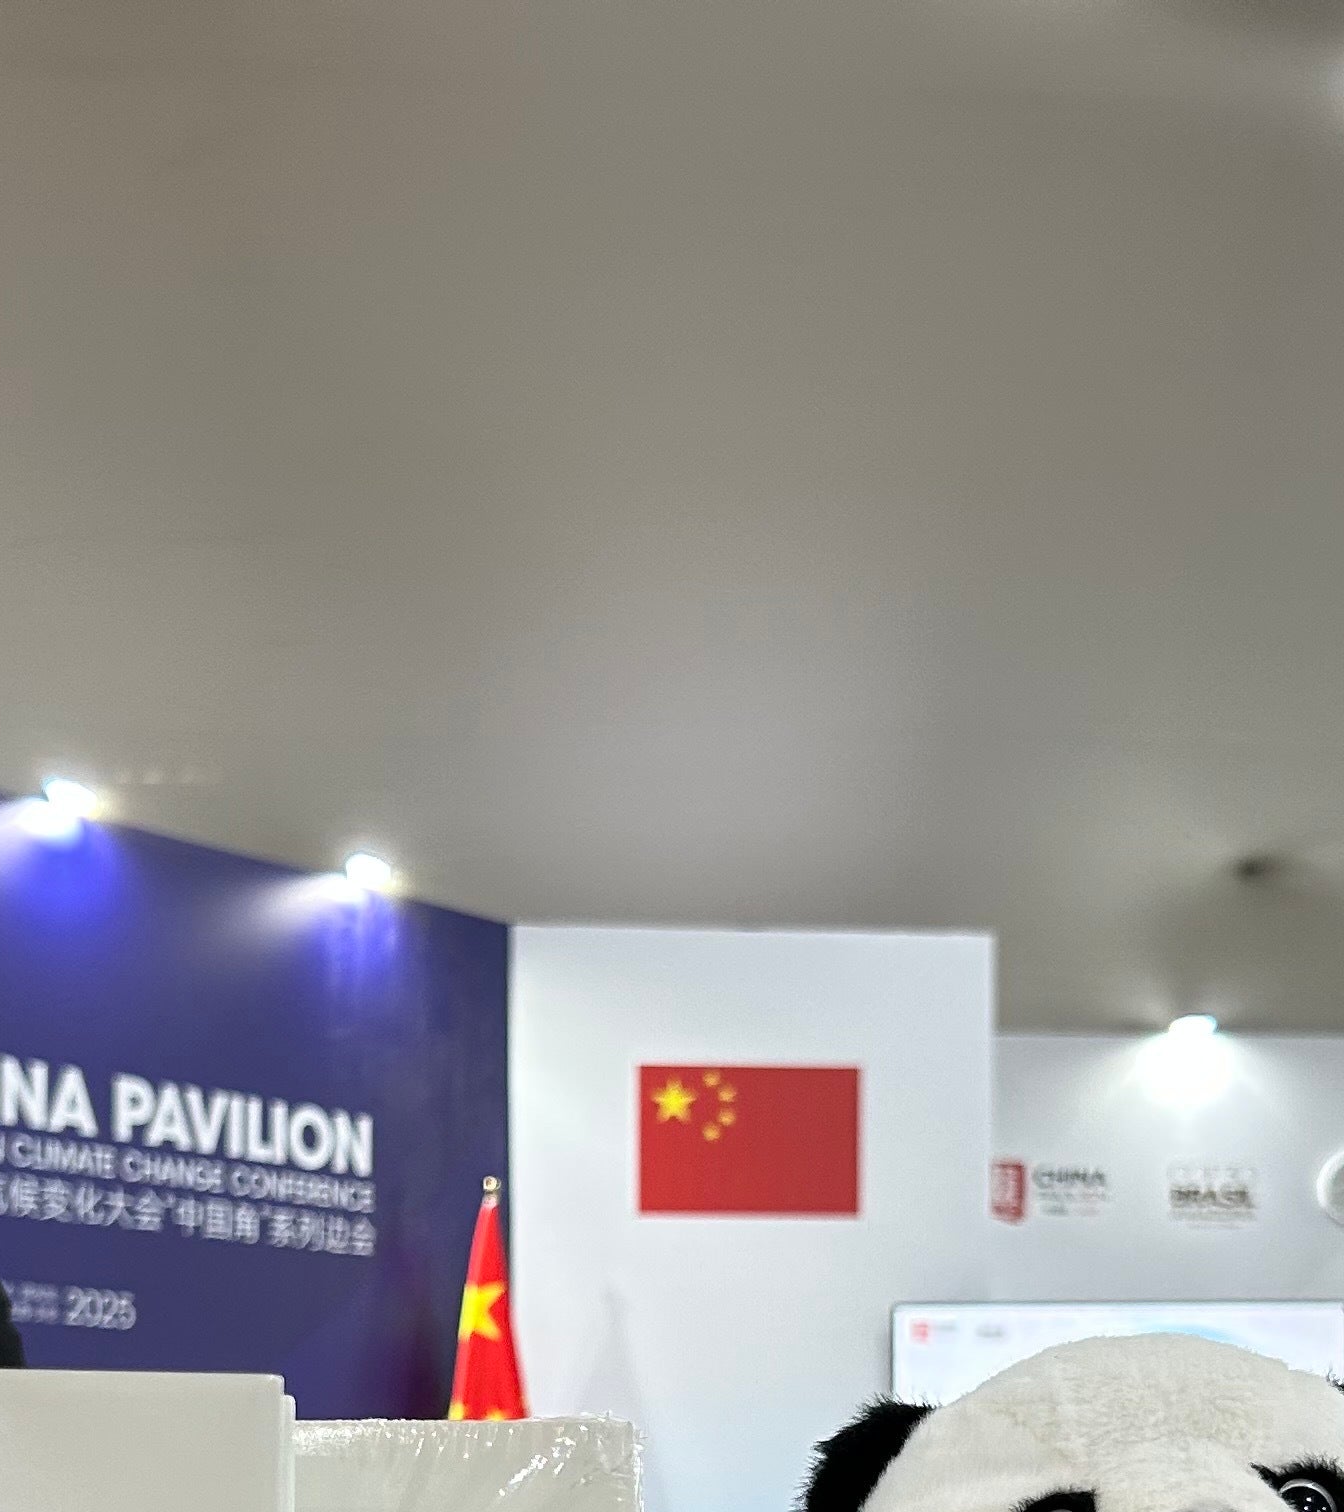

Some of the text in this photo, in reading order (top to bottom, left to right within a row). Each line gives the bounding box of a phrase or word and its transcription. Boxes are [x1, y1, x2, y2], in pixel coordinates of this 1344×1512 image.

[110, 1073, 374, 1178] PAVILION
[8, 1133, 117, 1180] CLIMATE
[119, 1149, 226, 1195] CHANGE
[229, 1164, 376, 1214] CONFERENCE
[63, 1286, 137, 1331] 2025
